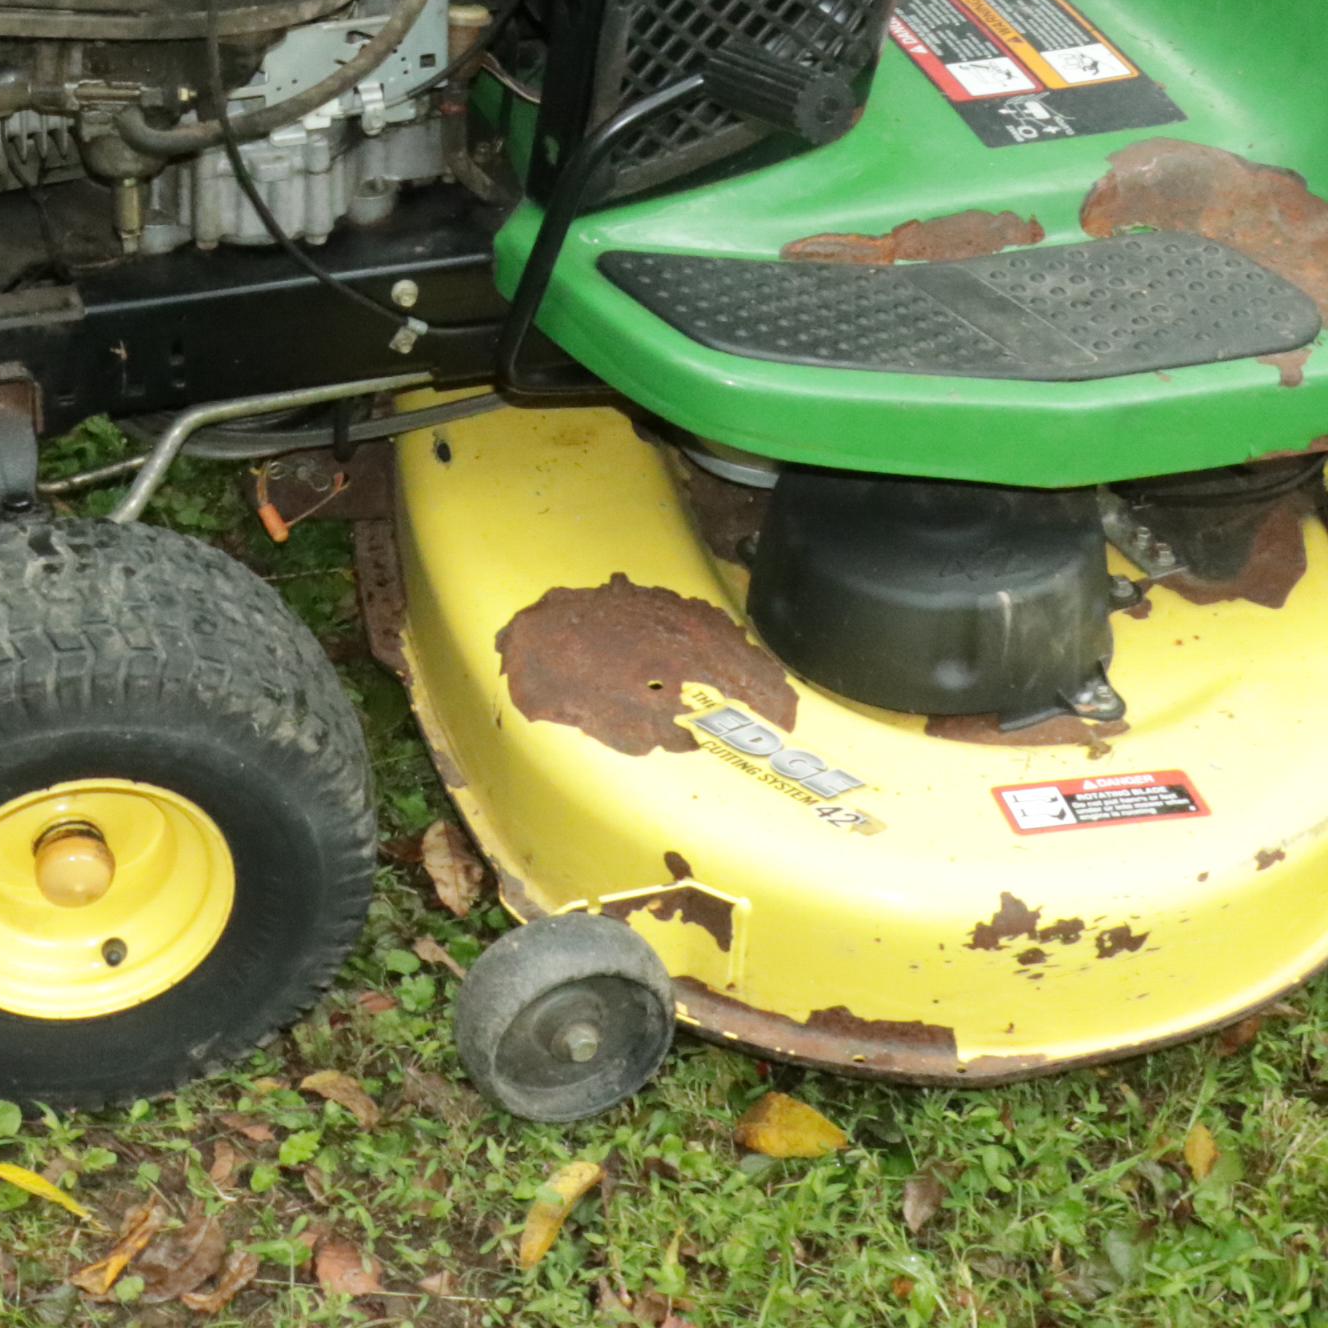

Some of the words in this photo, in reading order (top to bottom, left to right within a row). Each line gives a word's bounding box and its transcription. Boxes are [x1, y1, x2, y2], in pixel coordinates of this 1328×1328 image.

[690, 706, 867, 798] EDGE
[701, 740, 762, 776] CUTTING
[758, 771, 820, 806] SYSTEM
[1075, 789, 1130, 800] ROTATING
[1131, 786, 1168, 795] BLADE
[1096, 774, 1155, 788] DANGER
